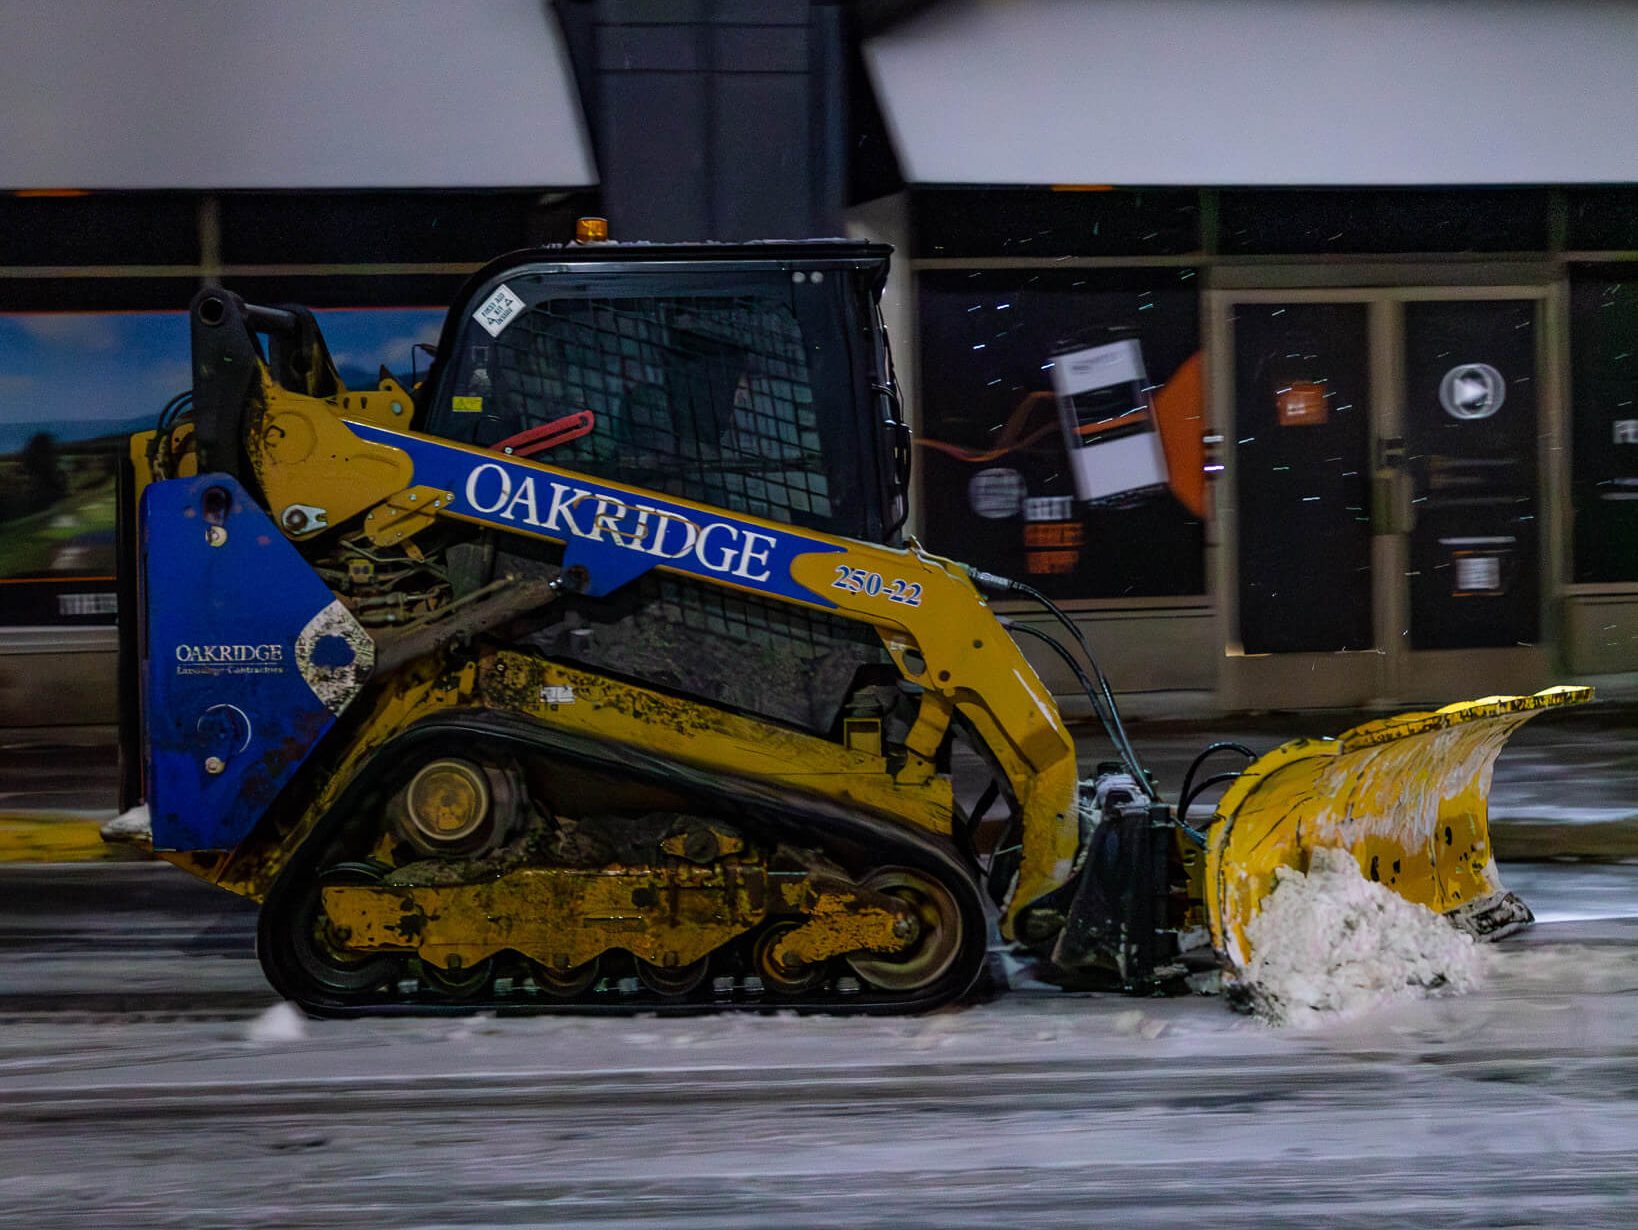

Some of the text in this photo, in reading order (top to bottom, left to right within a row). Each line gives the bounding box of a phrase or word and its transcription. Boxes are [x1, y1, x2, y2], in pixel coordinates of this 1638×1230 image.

[465, 463, 777, 583] OAKRIDGE
[831, 564, 923, 608] 250-22
[175, 644, 283, 662] OAKRIDGE
